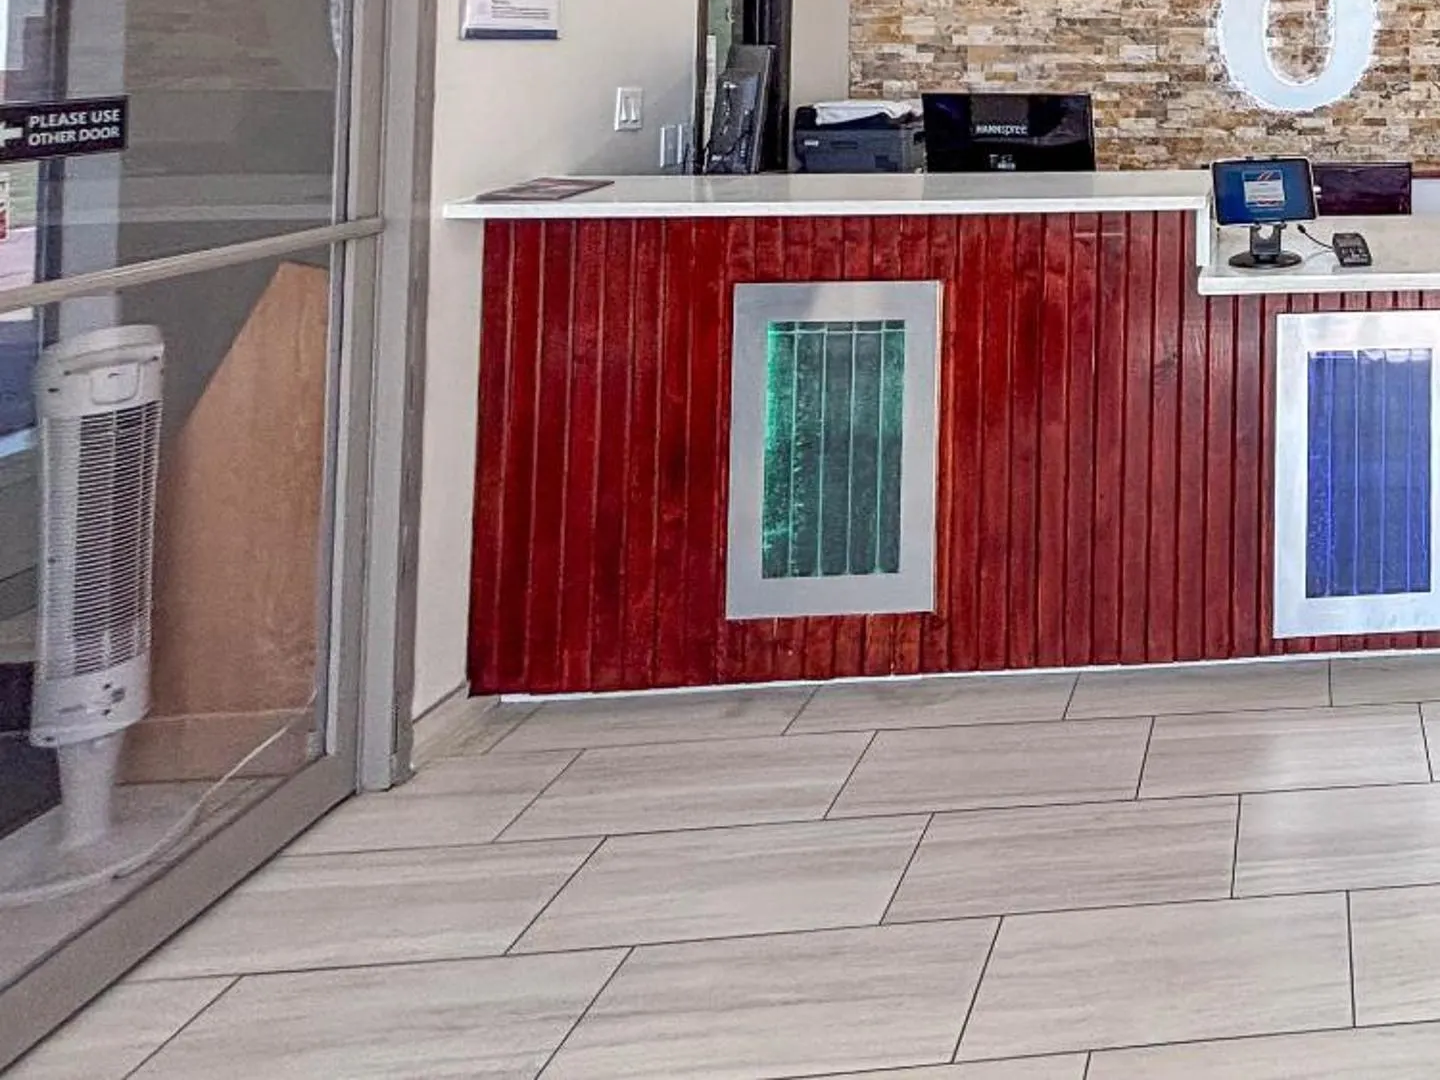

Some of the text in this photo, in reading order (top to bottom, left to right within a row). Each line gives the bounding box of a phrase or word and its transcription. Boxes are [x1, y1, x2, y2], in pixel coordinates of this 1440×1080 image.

[29, 109, 121, 129] PLEASE USE
[28, 126, 121, 146] OTHER DOOR
